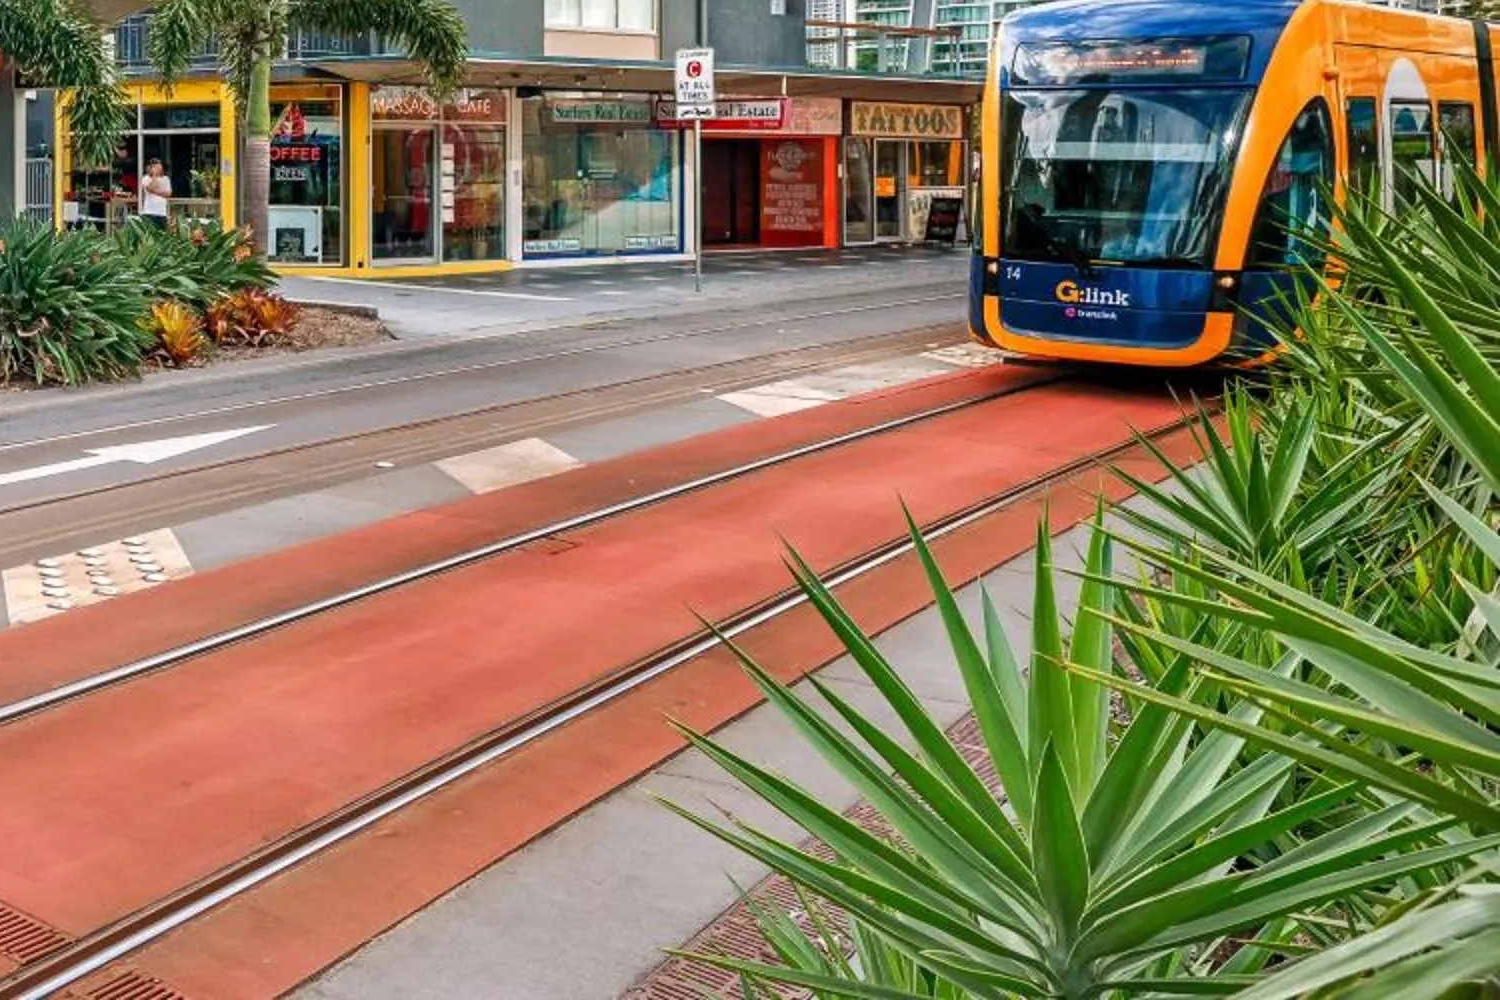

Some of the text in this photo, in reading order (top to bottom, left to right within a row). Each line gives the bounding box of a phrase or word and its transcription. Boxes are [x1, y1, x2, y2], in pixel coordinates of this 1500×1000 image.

[738, 103, 777, 117] Estate
[854, 104, 958, 134] TATTOOS
[270, 147, 321, 161] OFFEE
[1006, 267, 1021, 280] 14
